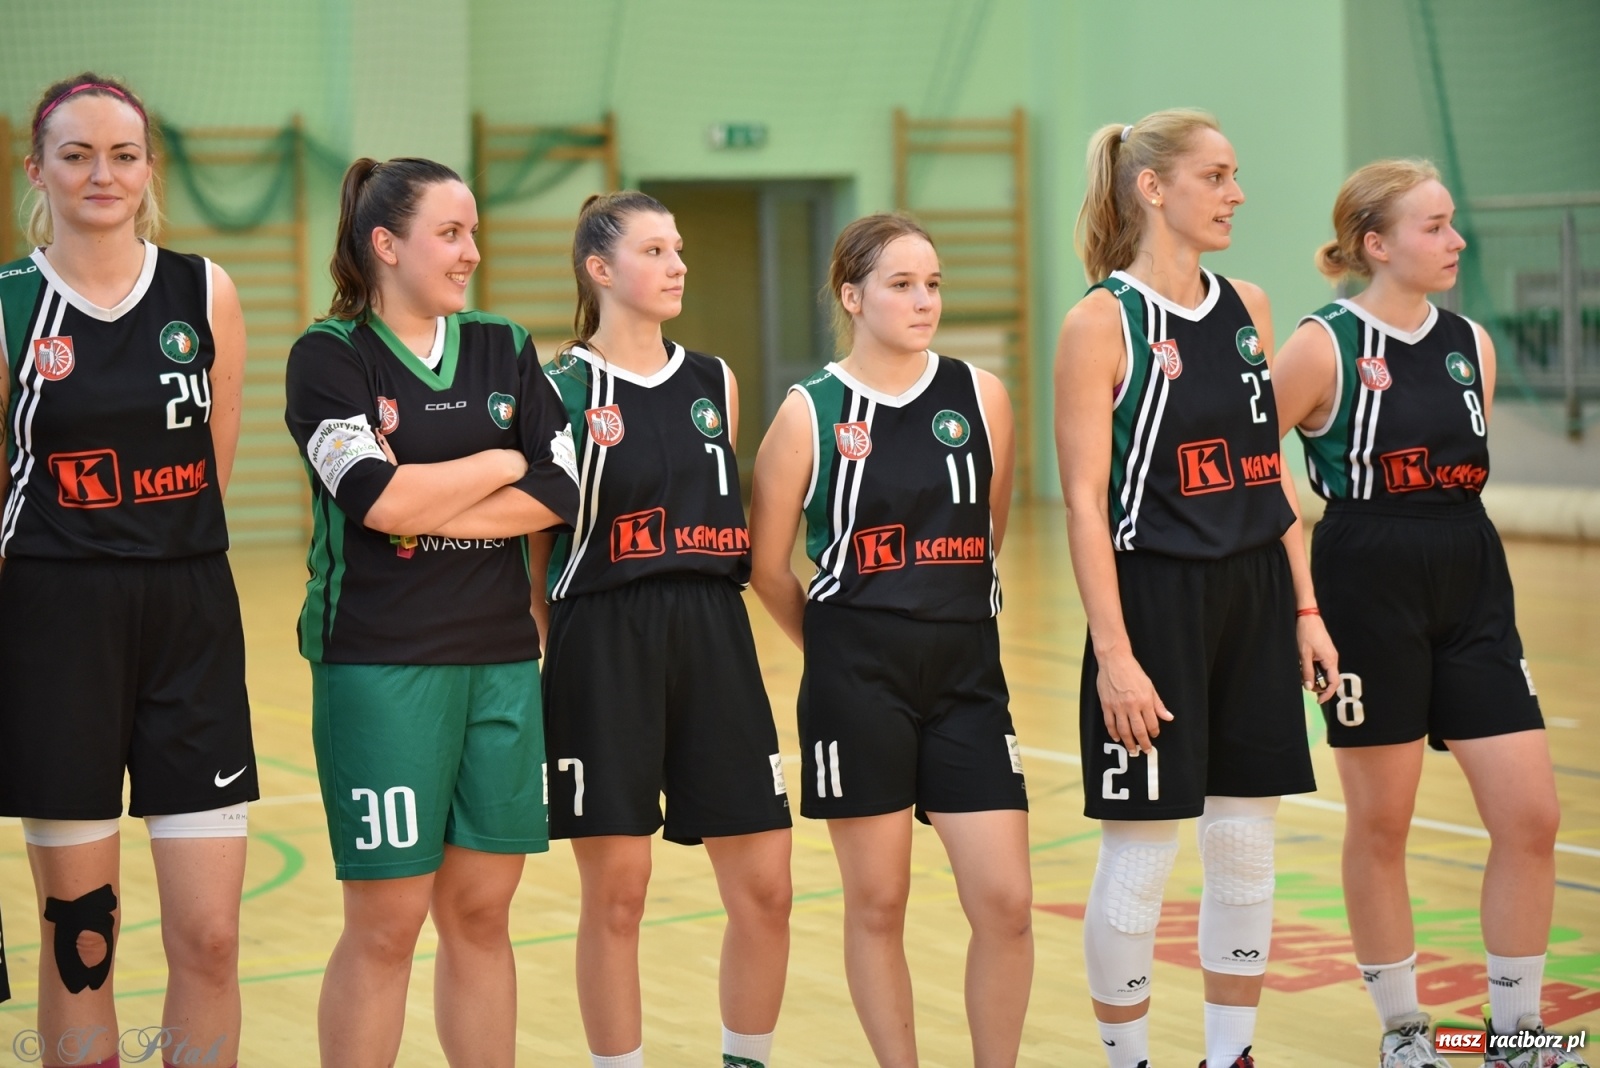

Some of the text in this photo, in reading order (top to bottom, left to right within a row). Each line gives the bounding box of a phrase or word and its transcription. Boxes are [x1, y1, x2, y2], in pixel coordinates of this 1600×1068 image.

[0, 265, 37, 279] COLO
[160, 368, 211, 430] 24
[425, 401, 467, 411] COLO
[1241, 369, 1270, 424] 2
[1463, 390, 1486, 437] 8
[54, 457, 116, 501] K
[325, 458, 346, 486] Marcin
[704, 442, 728, 496] 7
[946, 452, 976, 504] 11
[1182, 446, 1280, 490] K KAM
[1387, 454, 1428, 488] K
[616, 515, 750, 558] K KAMAN
[858, 531, 984, 569] K KAMAN
[1336, 673, 1365, 727] 8
[558, 758, 585, 817] 7
[814, 740, 843, 798] 11
[1102, 742, 1159, 800] 27
[351, 786, 419, 850] 30
